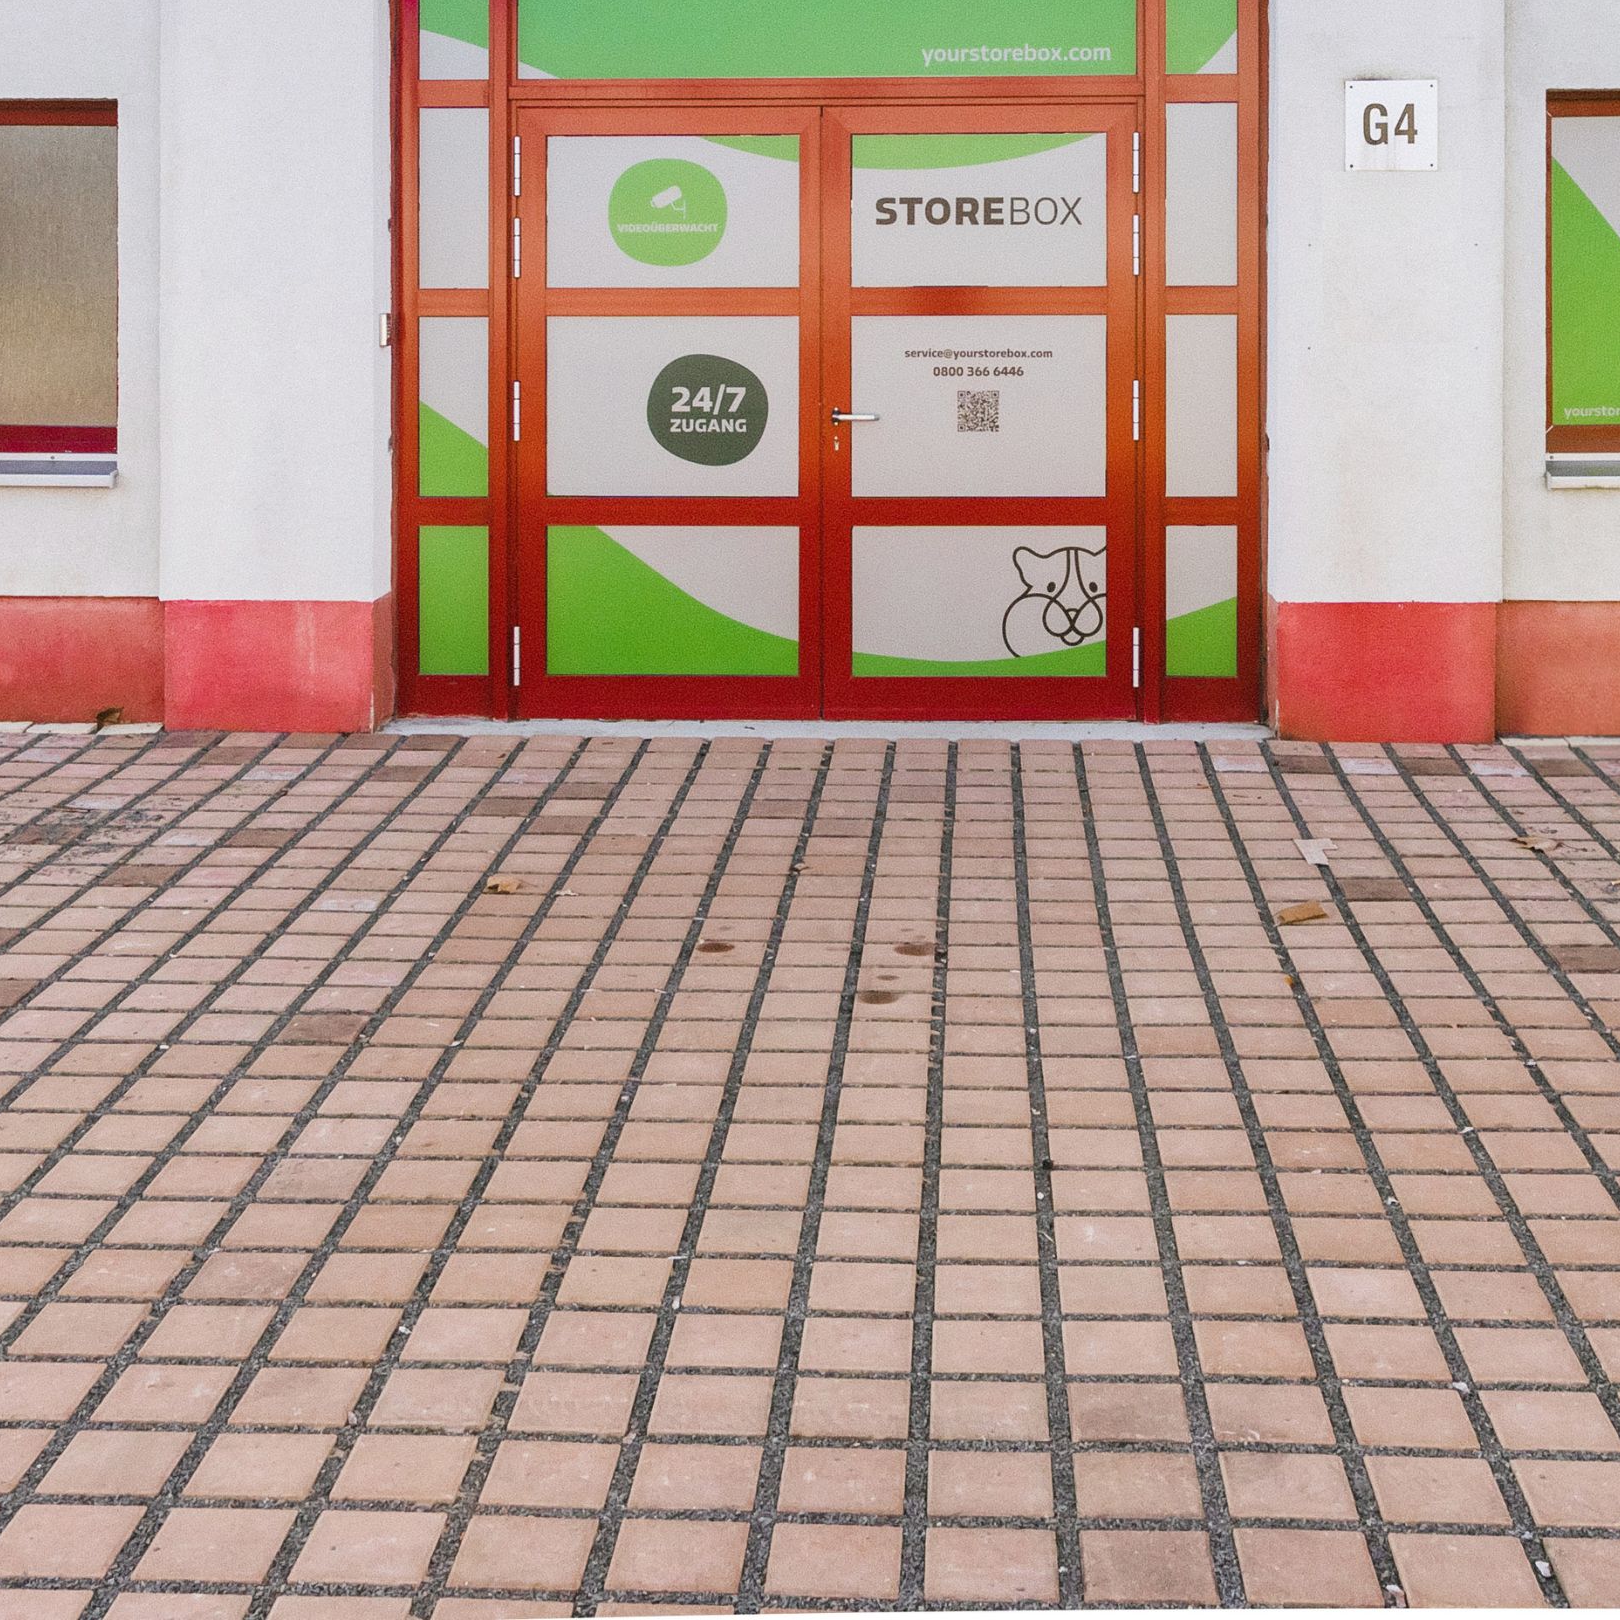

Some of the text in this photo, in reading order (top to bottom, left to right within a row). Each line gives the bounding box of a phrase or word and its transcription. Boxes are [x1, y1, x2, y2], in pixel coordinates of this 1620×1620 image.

[921, 44, 1112, 68] yourstorebox.com
[1363, 103, 1418, 145] G4
[875, 196, 1083, 226] STOREBOX
[904, 348, 1053, 360] service@yourstorebox.com
[933, 366, 1024, 377] 0800 366 6446
[670, 384, 747, 415] 24/7
[669, 418, 747, 433] ZUGANG
